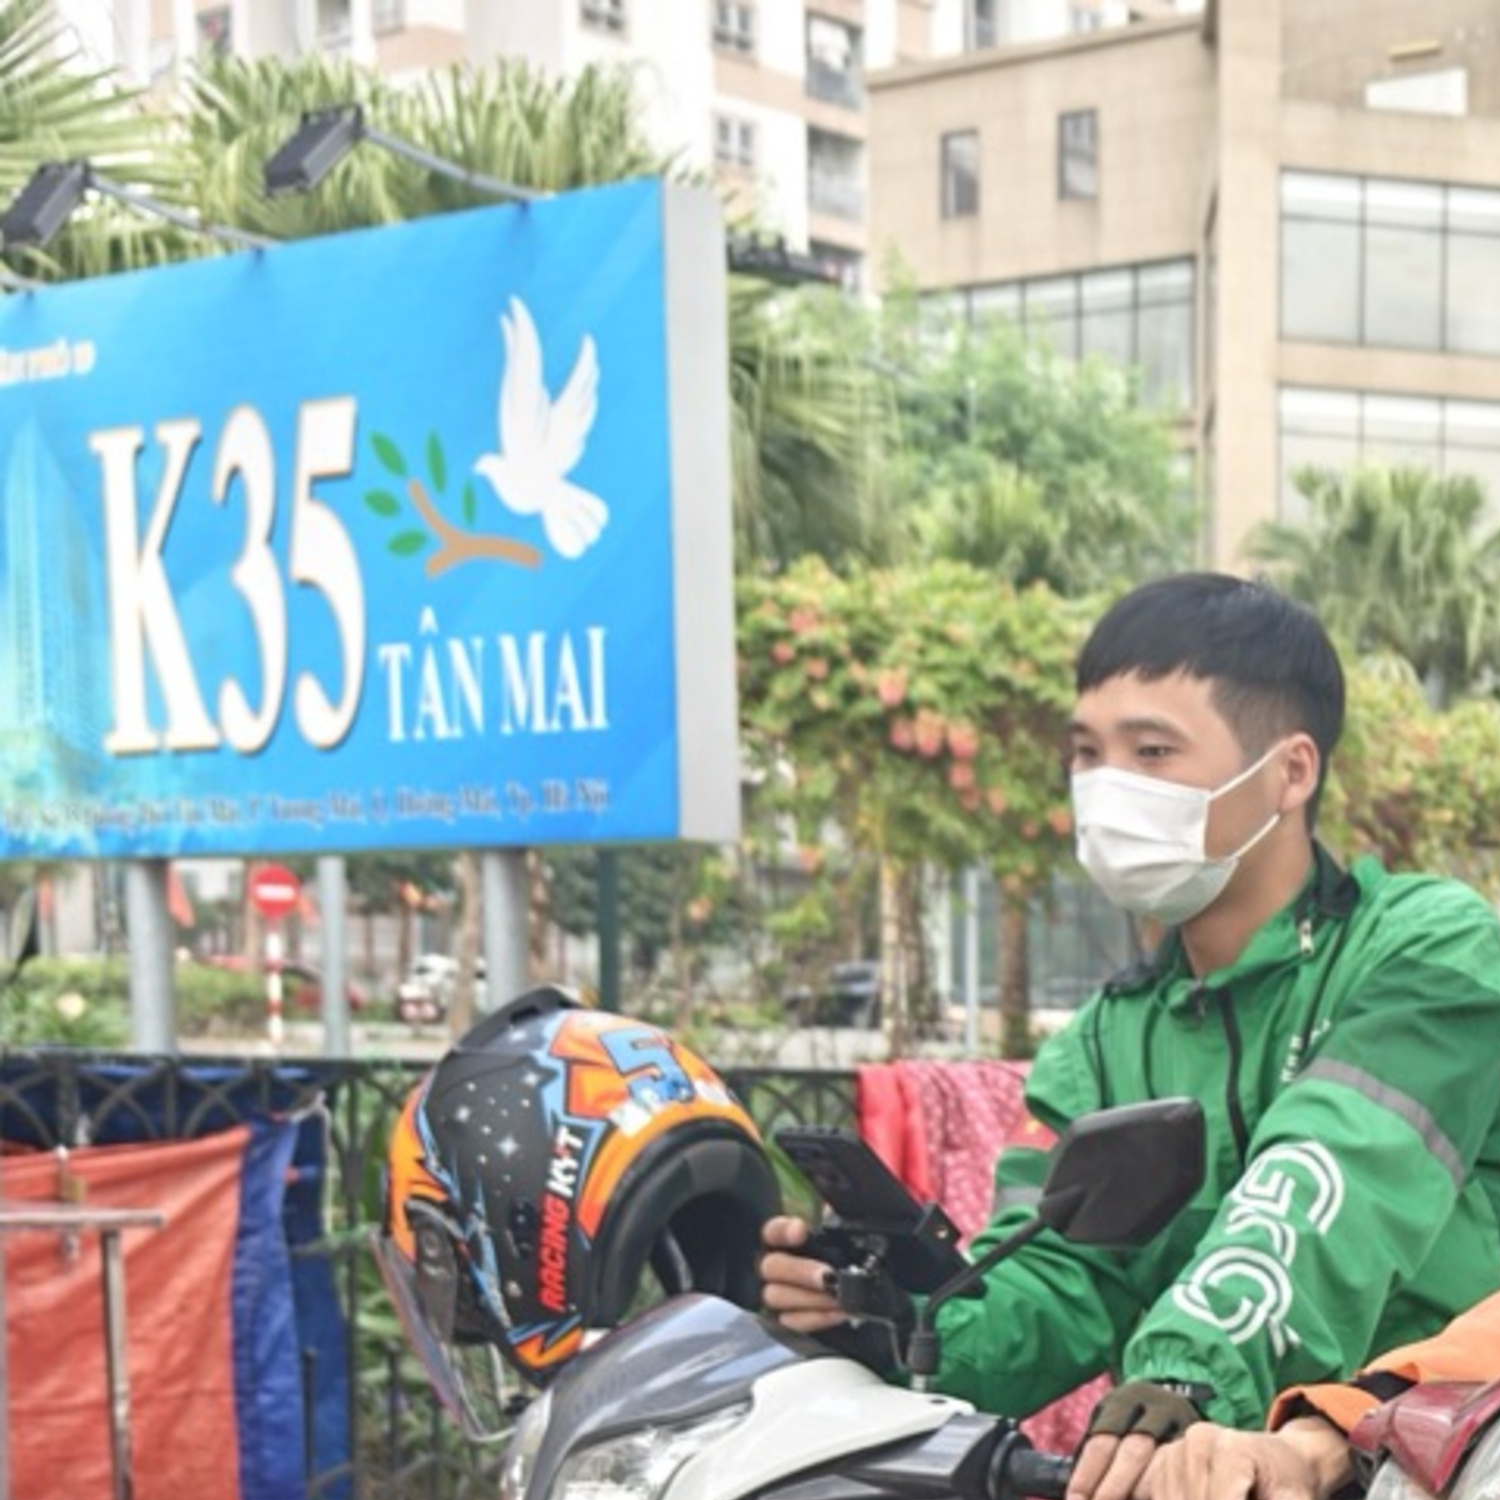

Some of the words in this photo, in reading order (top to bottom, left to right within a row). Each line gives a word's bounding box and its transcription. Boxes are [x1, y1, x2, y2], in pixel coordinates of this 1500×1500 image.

[87, 394, 365, 757] K35
[378, 606, 485, 742] TÂN
[498, 624, 609, 736] MAI
[546, 1124, 584, 1198] KYT
[538, 1192, 571, 1314] RACING
